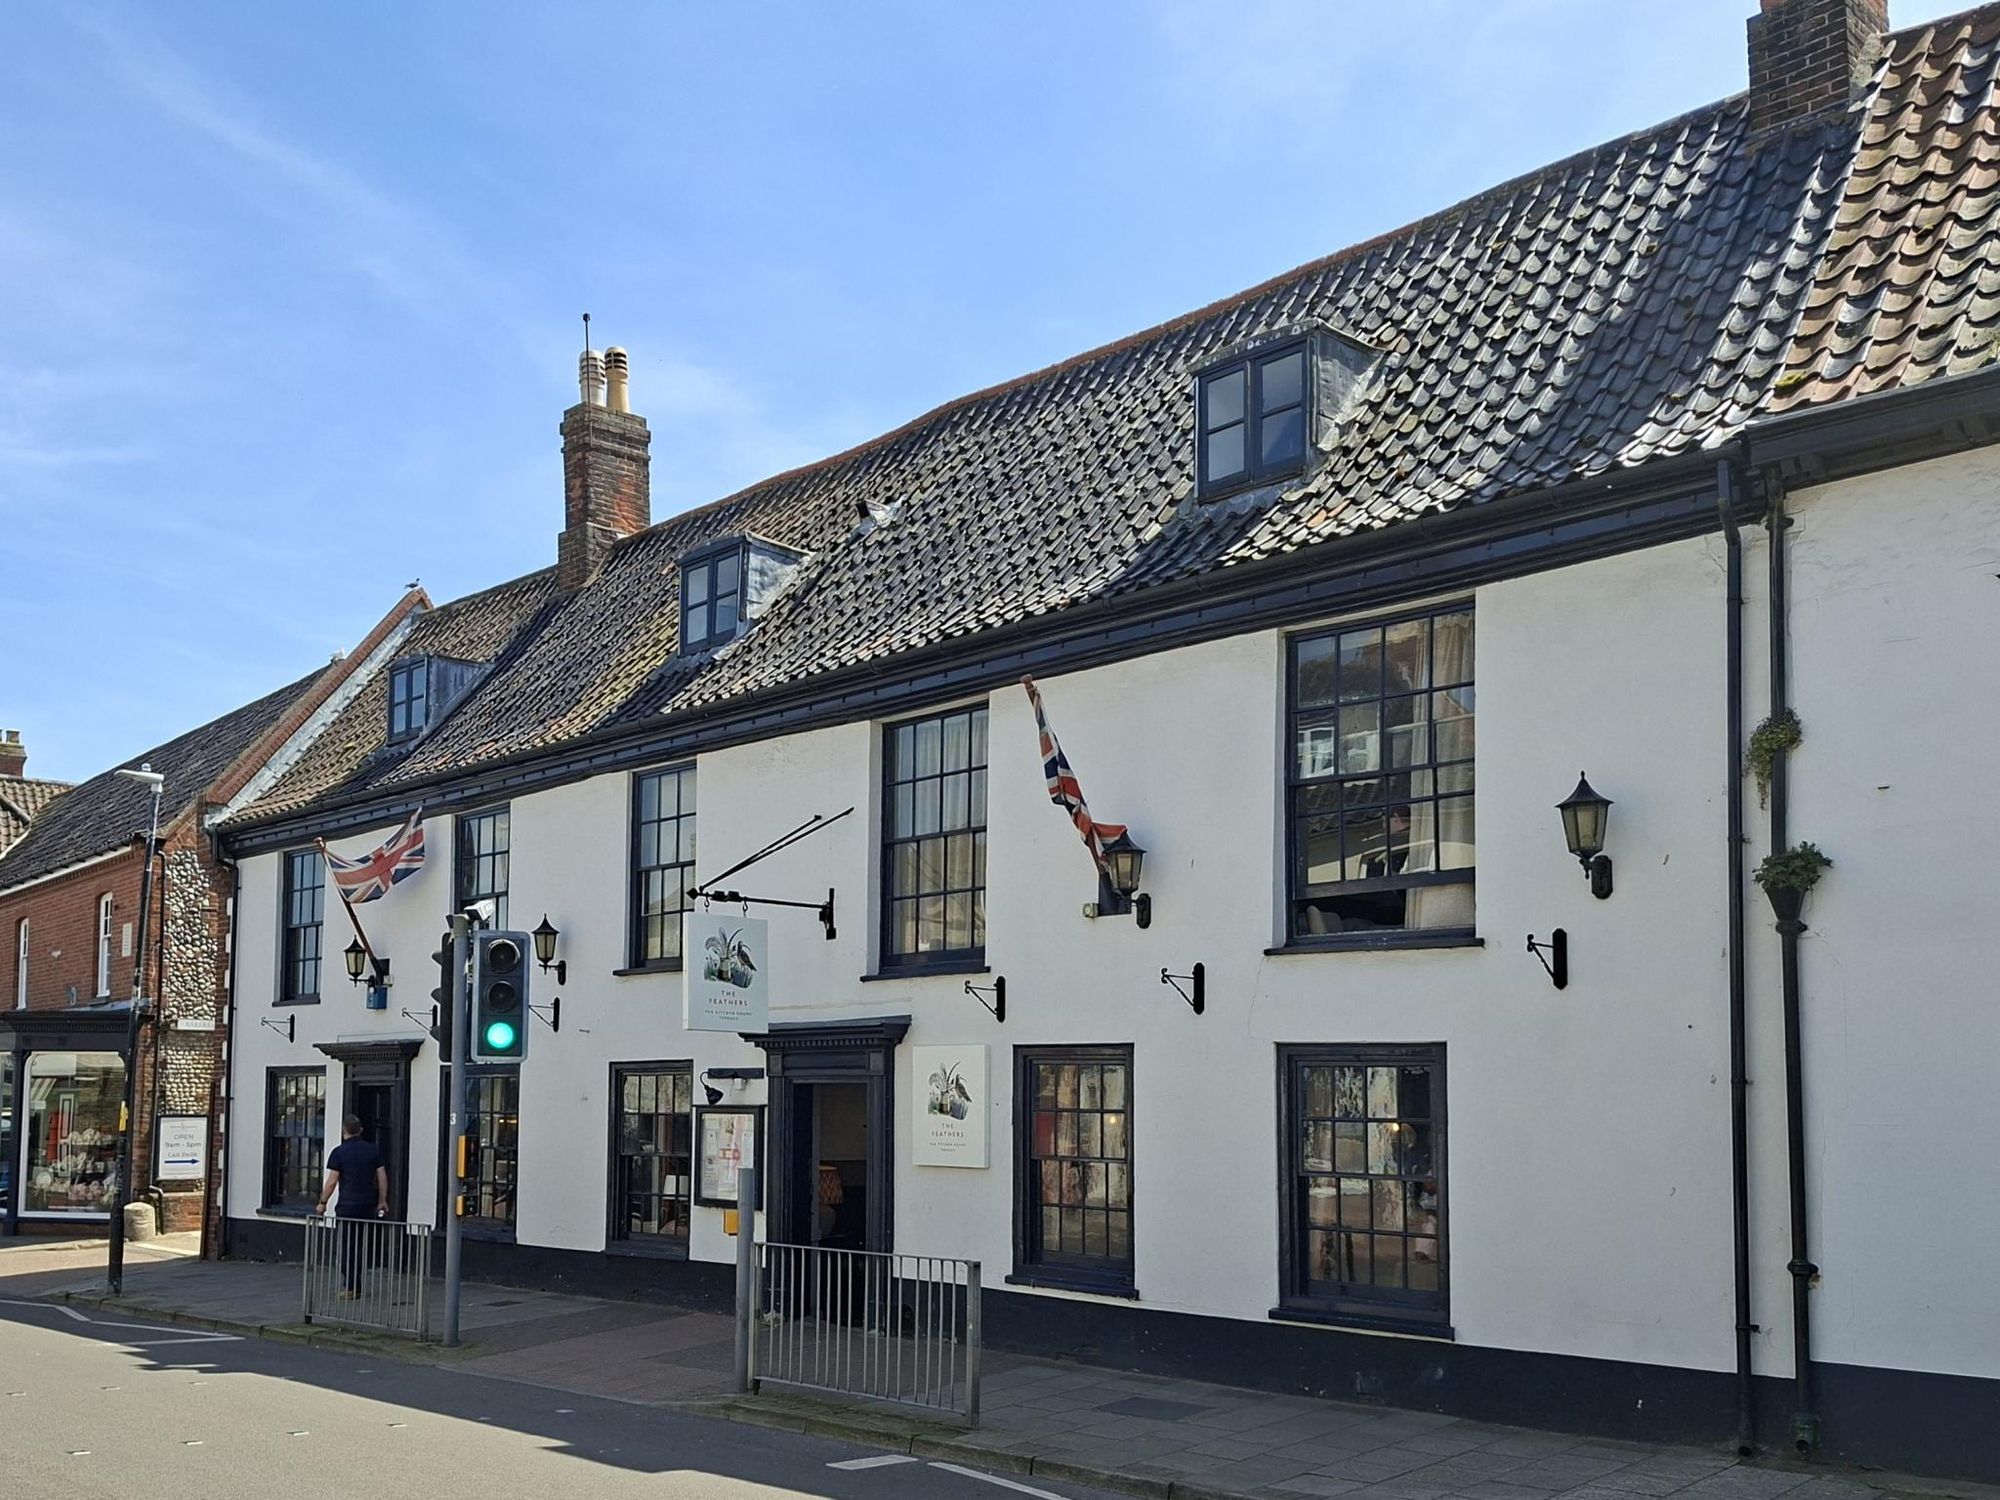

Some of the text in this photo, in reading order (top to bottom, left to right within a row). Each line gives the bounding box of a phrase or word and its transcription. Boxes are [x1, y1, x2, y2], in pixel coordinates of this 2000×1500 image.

[709, 998, 748, 1006] FEATHERS
[450, 1112, 457, 1125] 3
[931, 1130, 964, 1138] FEATHERS
